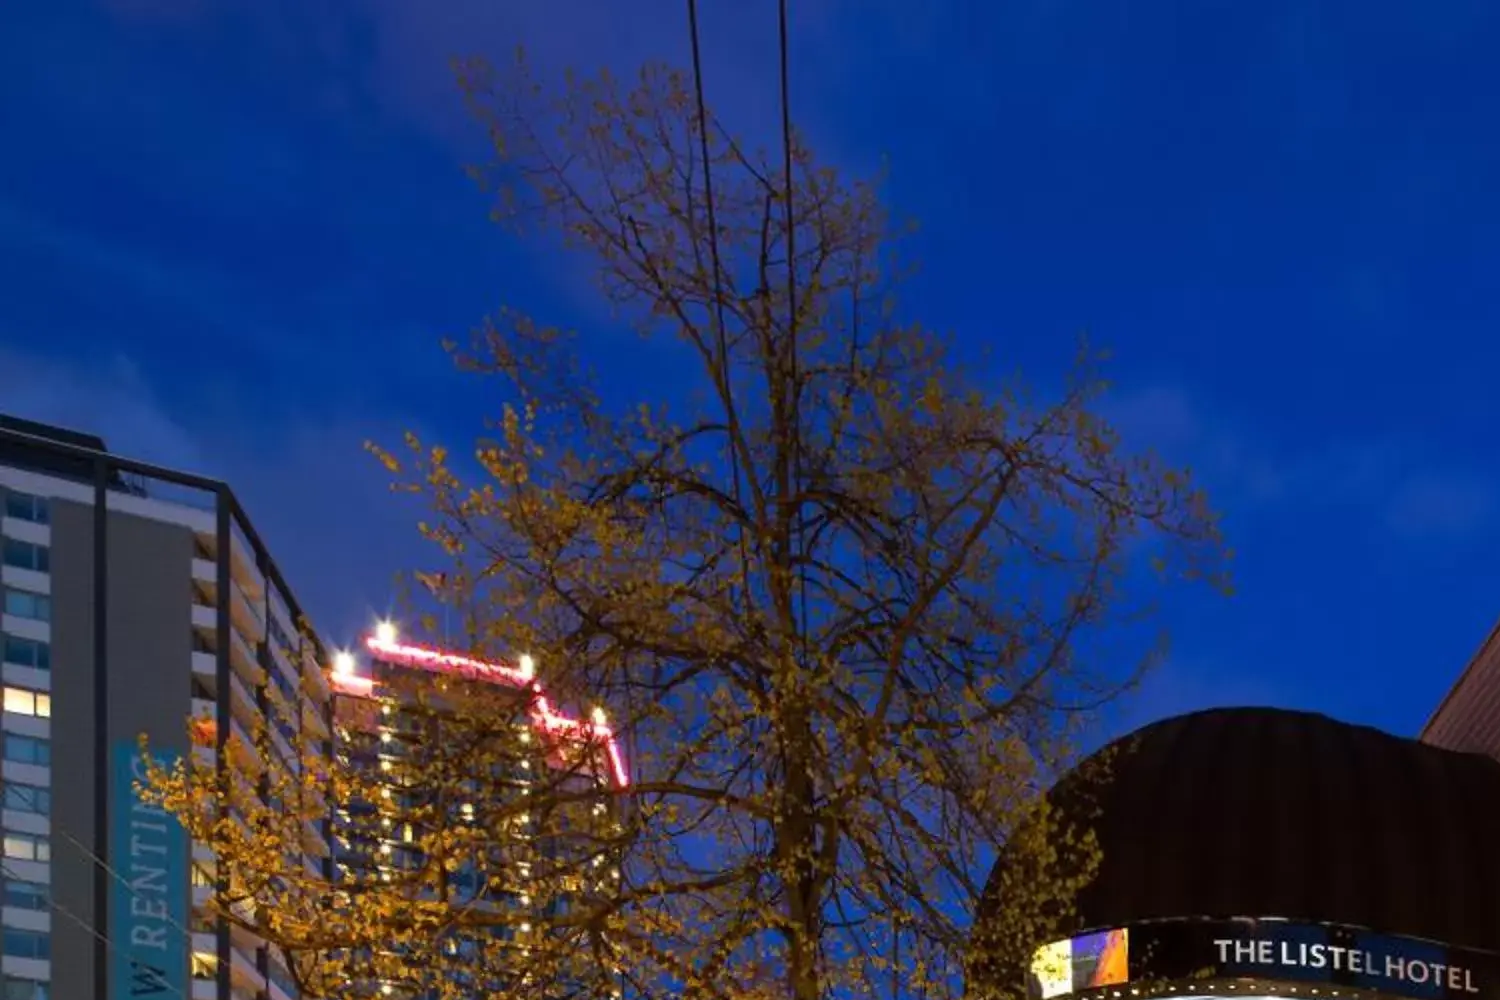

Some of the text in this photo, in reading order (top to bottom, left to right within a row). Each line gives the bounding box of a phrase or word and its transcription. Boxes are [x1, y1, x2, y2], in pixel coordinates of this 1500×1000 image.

[1213, 939, 1480, 993] THE LISTEL HOTEL
